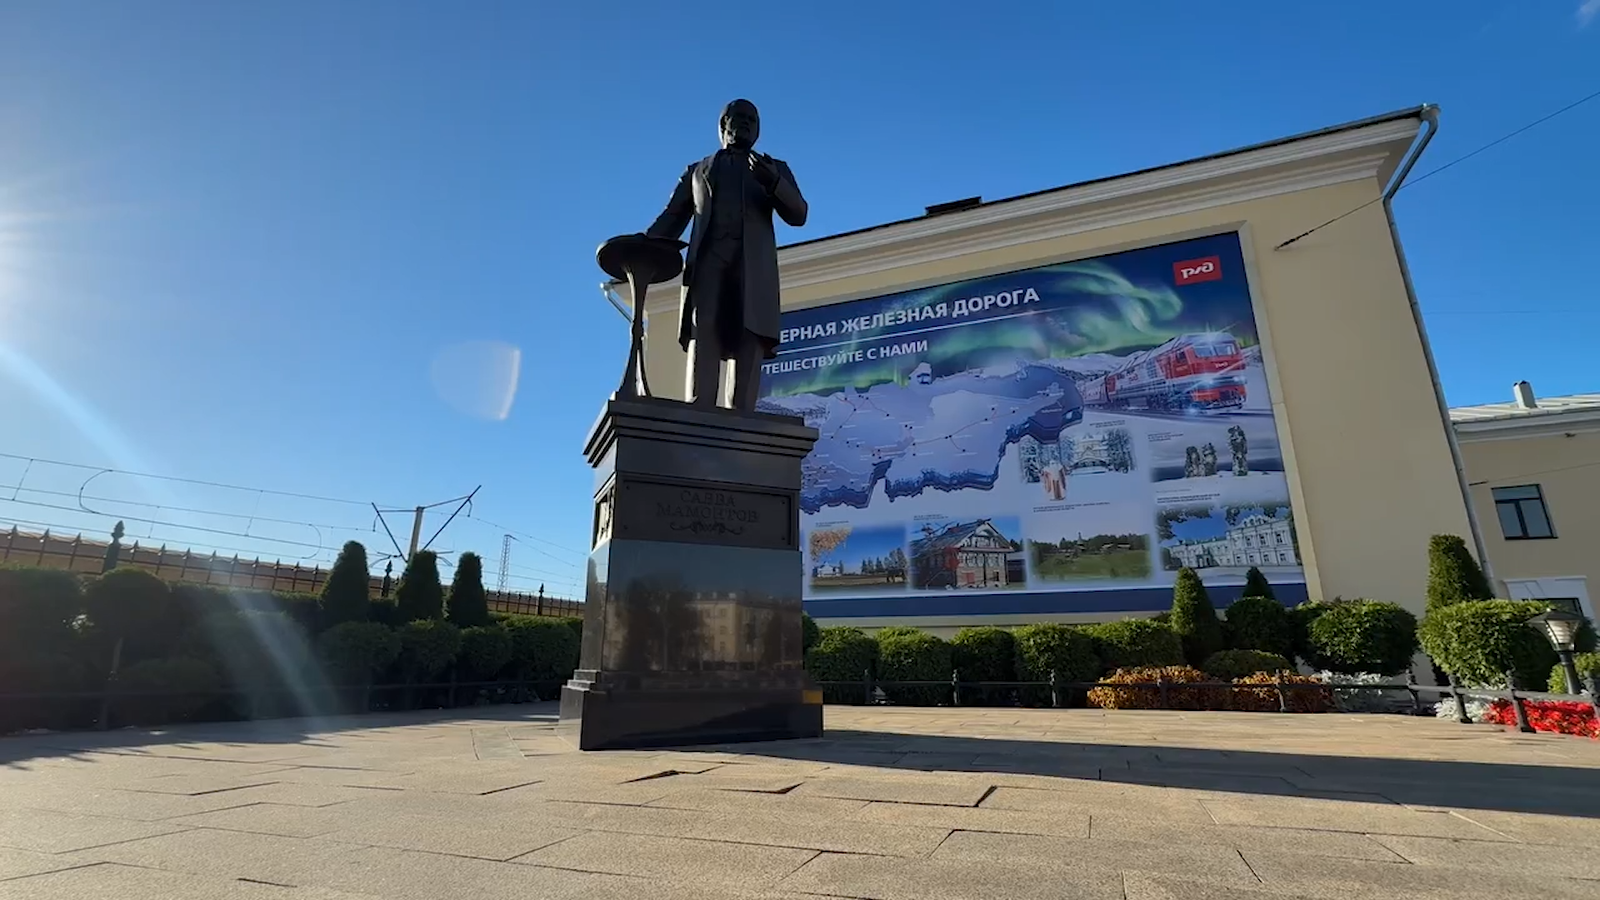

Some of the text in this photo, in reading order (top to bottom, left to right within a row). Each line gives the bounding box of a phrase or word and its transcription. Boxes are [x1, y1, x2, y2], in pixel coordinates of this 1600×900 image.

[841, 303, 948, 334] ЖЕЛЕЗНАЯ
[952, 288, 1040, 318] ДОРОГА
[867, 348, 878, 360] С
[880, 340, 928, 358] НАМИ
[680, 490, 736, 507] САВВА
[656, 502, 760, 523] МАМОНТОВ
